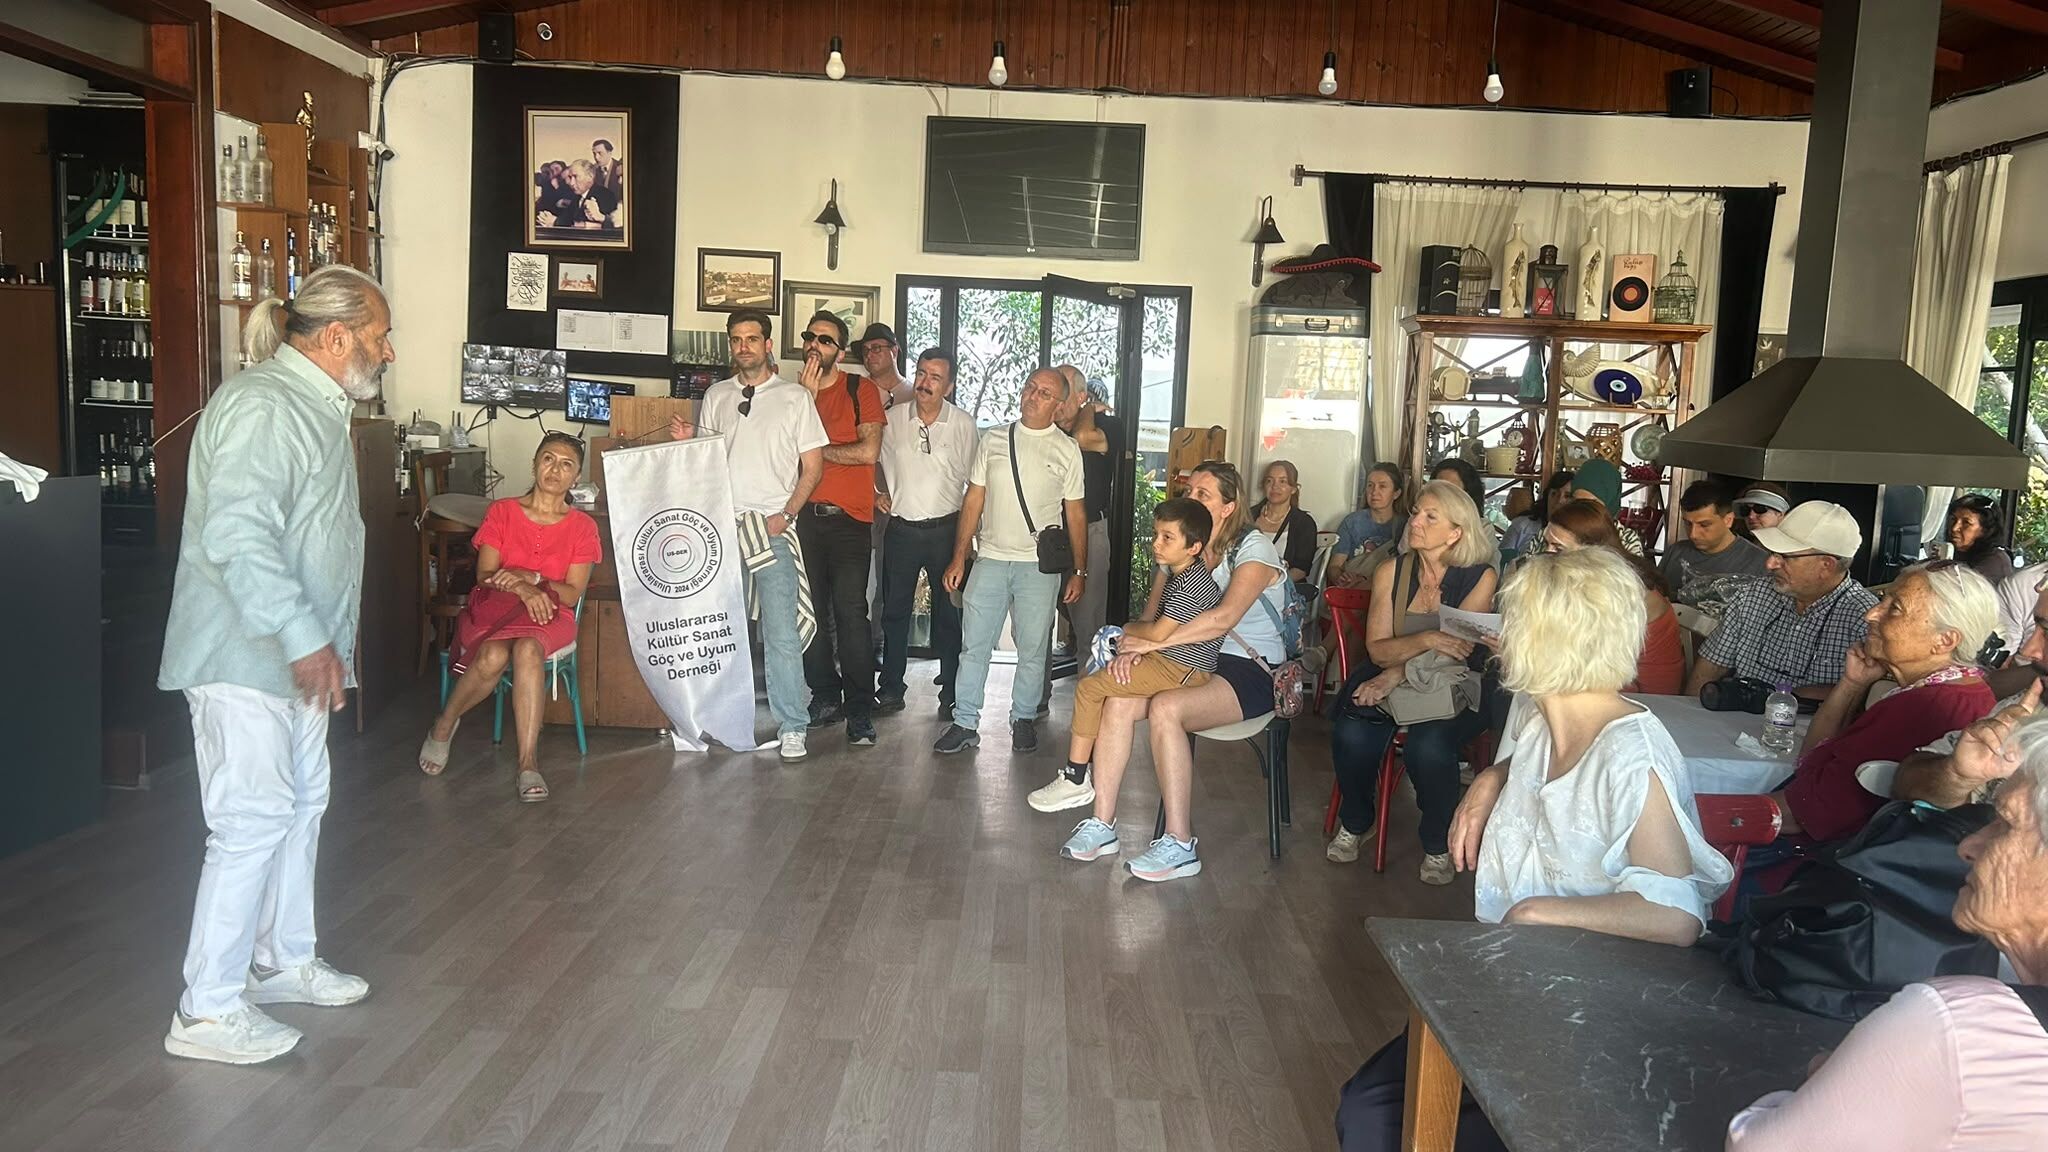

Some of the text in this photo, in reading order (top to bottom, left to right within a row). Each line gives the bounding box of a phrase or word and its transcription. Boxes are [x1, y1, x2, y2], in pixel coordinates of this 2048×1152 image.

[637, 513, 718, 593] Uluslararası Kültür Sanat Göç ve Uyum Derneği
[666, 549, 688, 557] US-DER
[675, 584, 690, 593] 2024
[646, 612, 728, 633] Uluslararası
[647, 625, 733, 650] Kültür Sanat
[648, 643, 736, 666] Göç ve Uyum
[667, 659, 721, 680] Derneği
